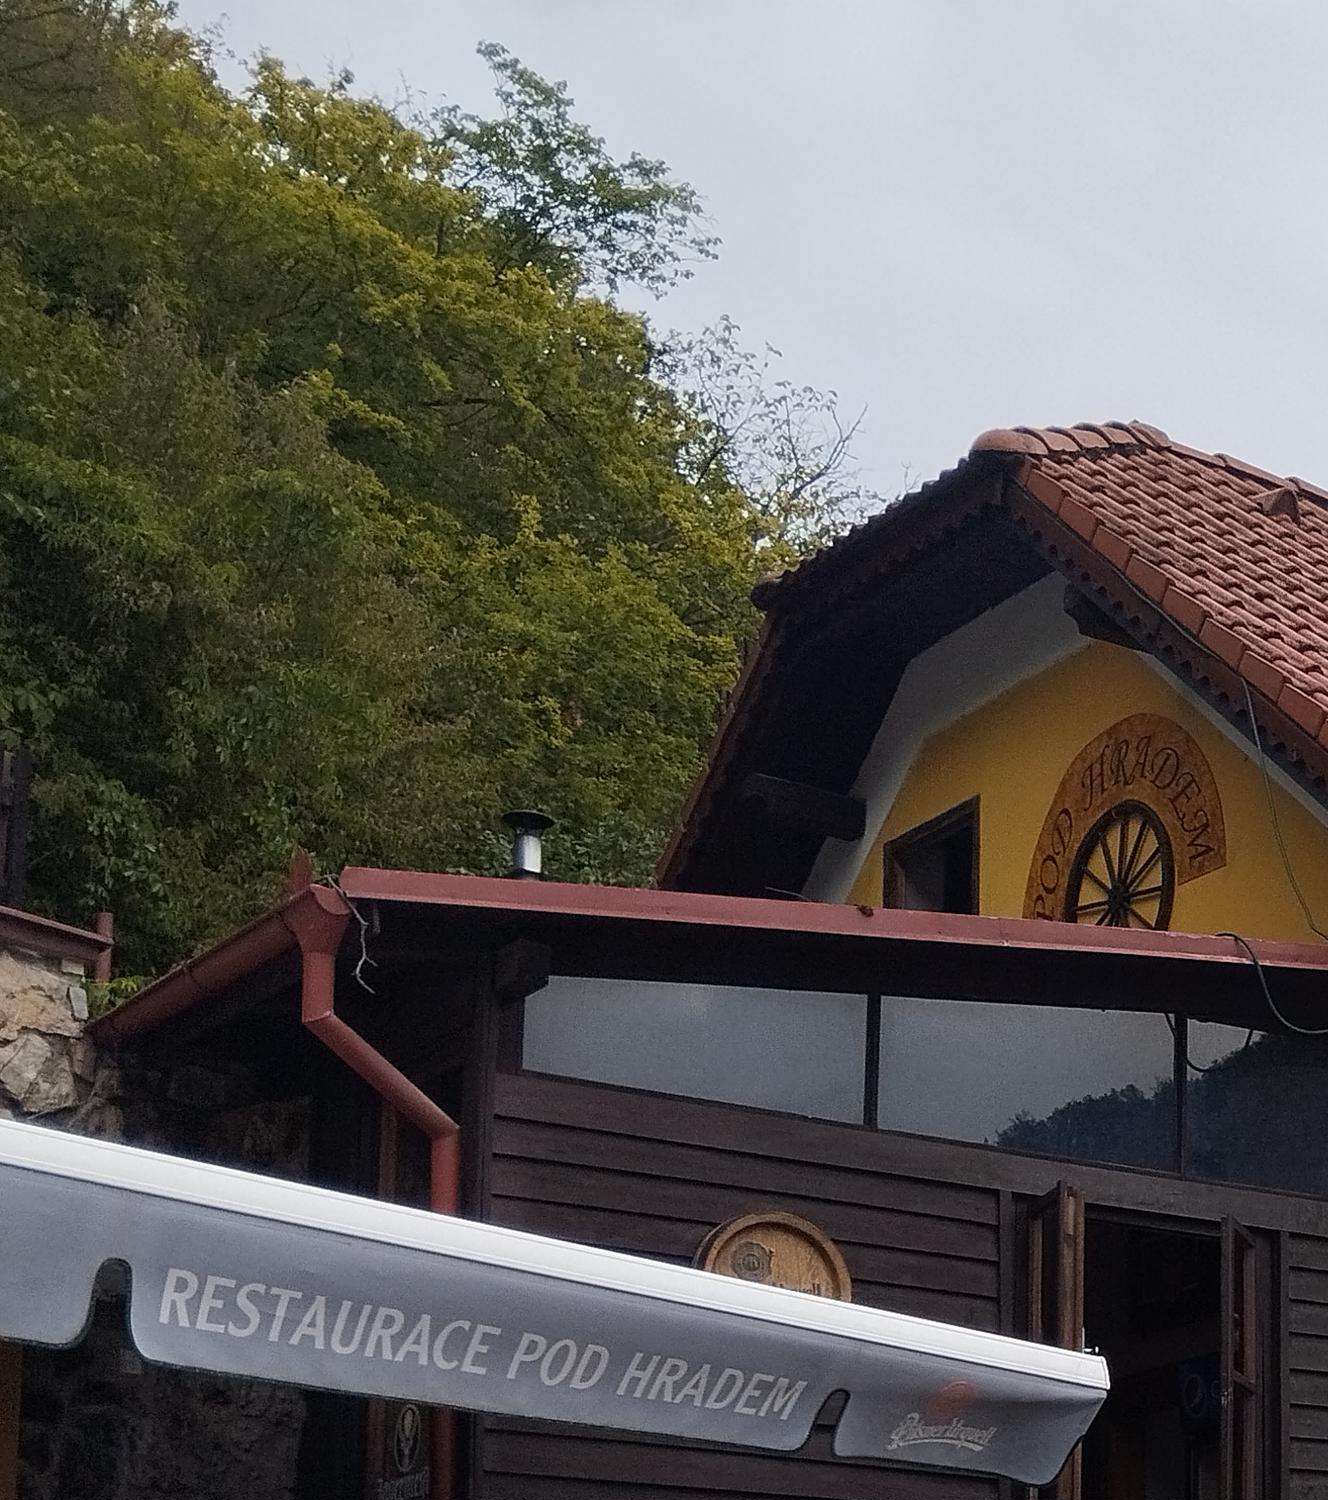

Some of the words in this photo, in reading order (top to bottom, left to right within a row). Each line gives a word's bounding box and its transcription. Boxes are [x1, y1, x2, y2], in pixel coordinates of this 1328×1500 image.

[1032, 806, 1075, 922] POD
[1081, 734, 1217, 870] HRADEM
[158, 1267, 502, 1375] RESTAURACE
[506, 1332, 609, 1390] POD
[616, 1352, 808, 1420] HRADEM
